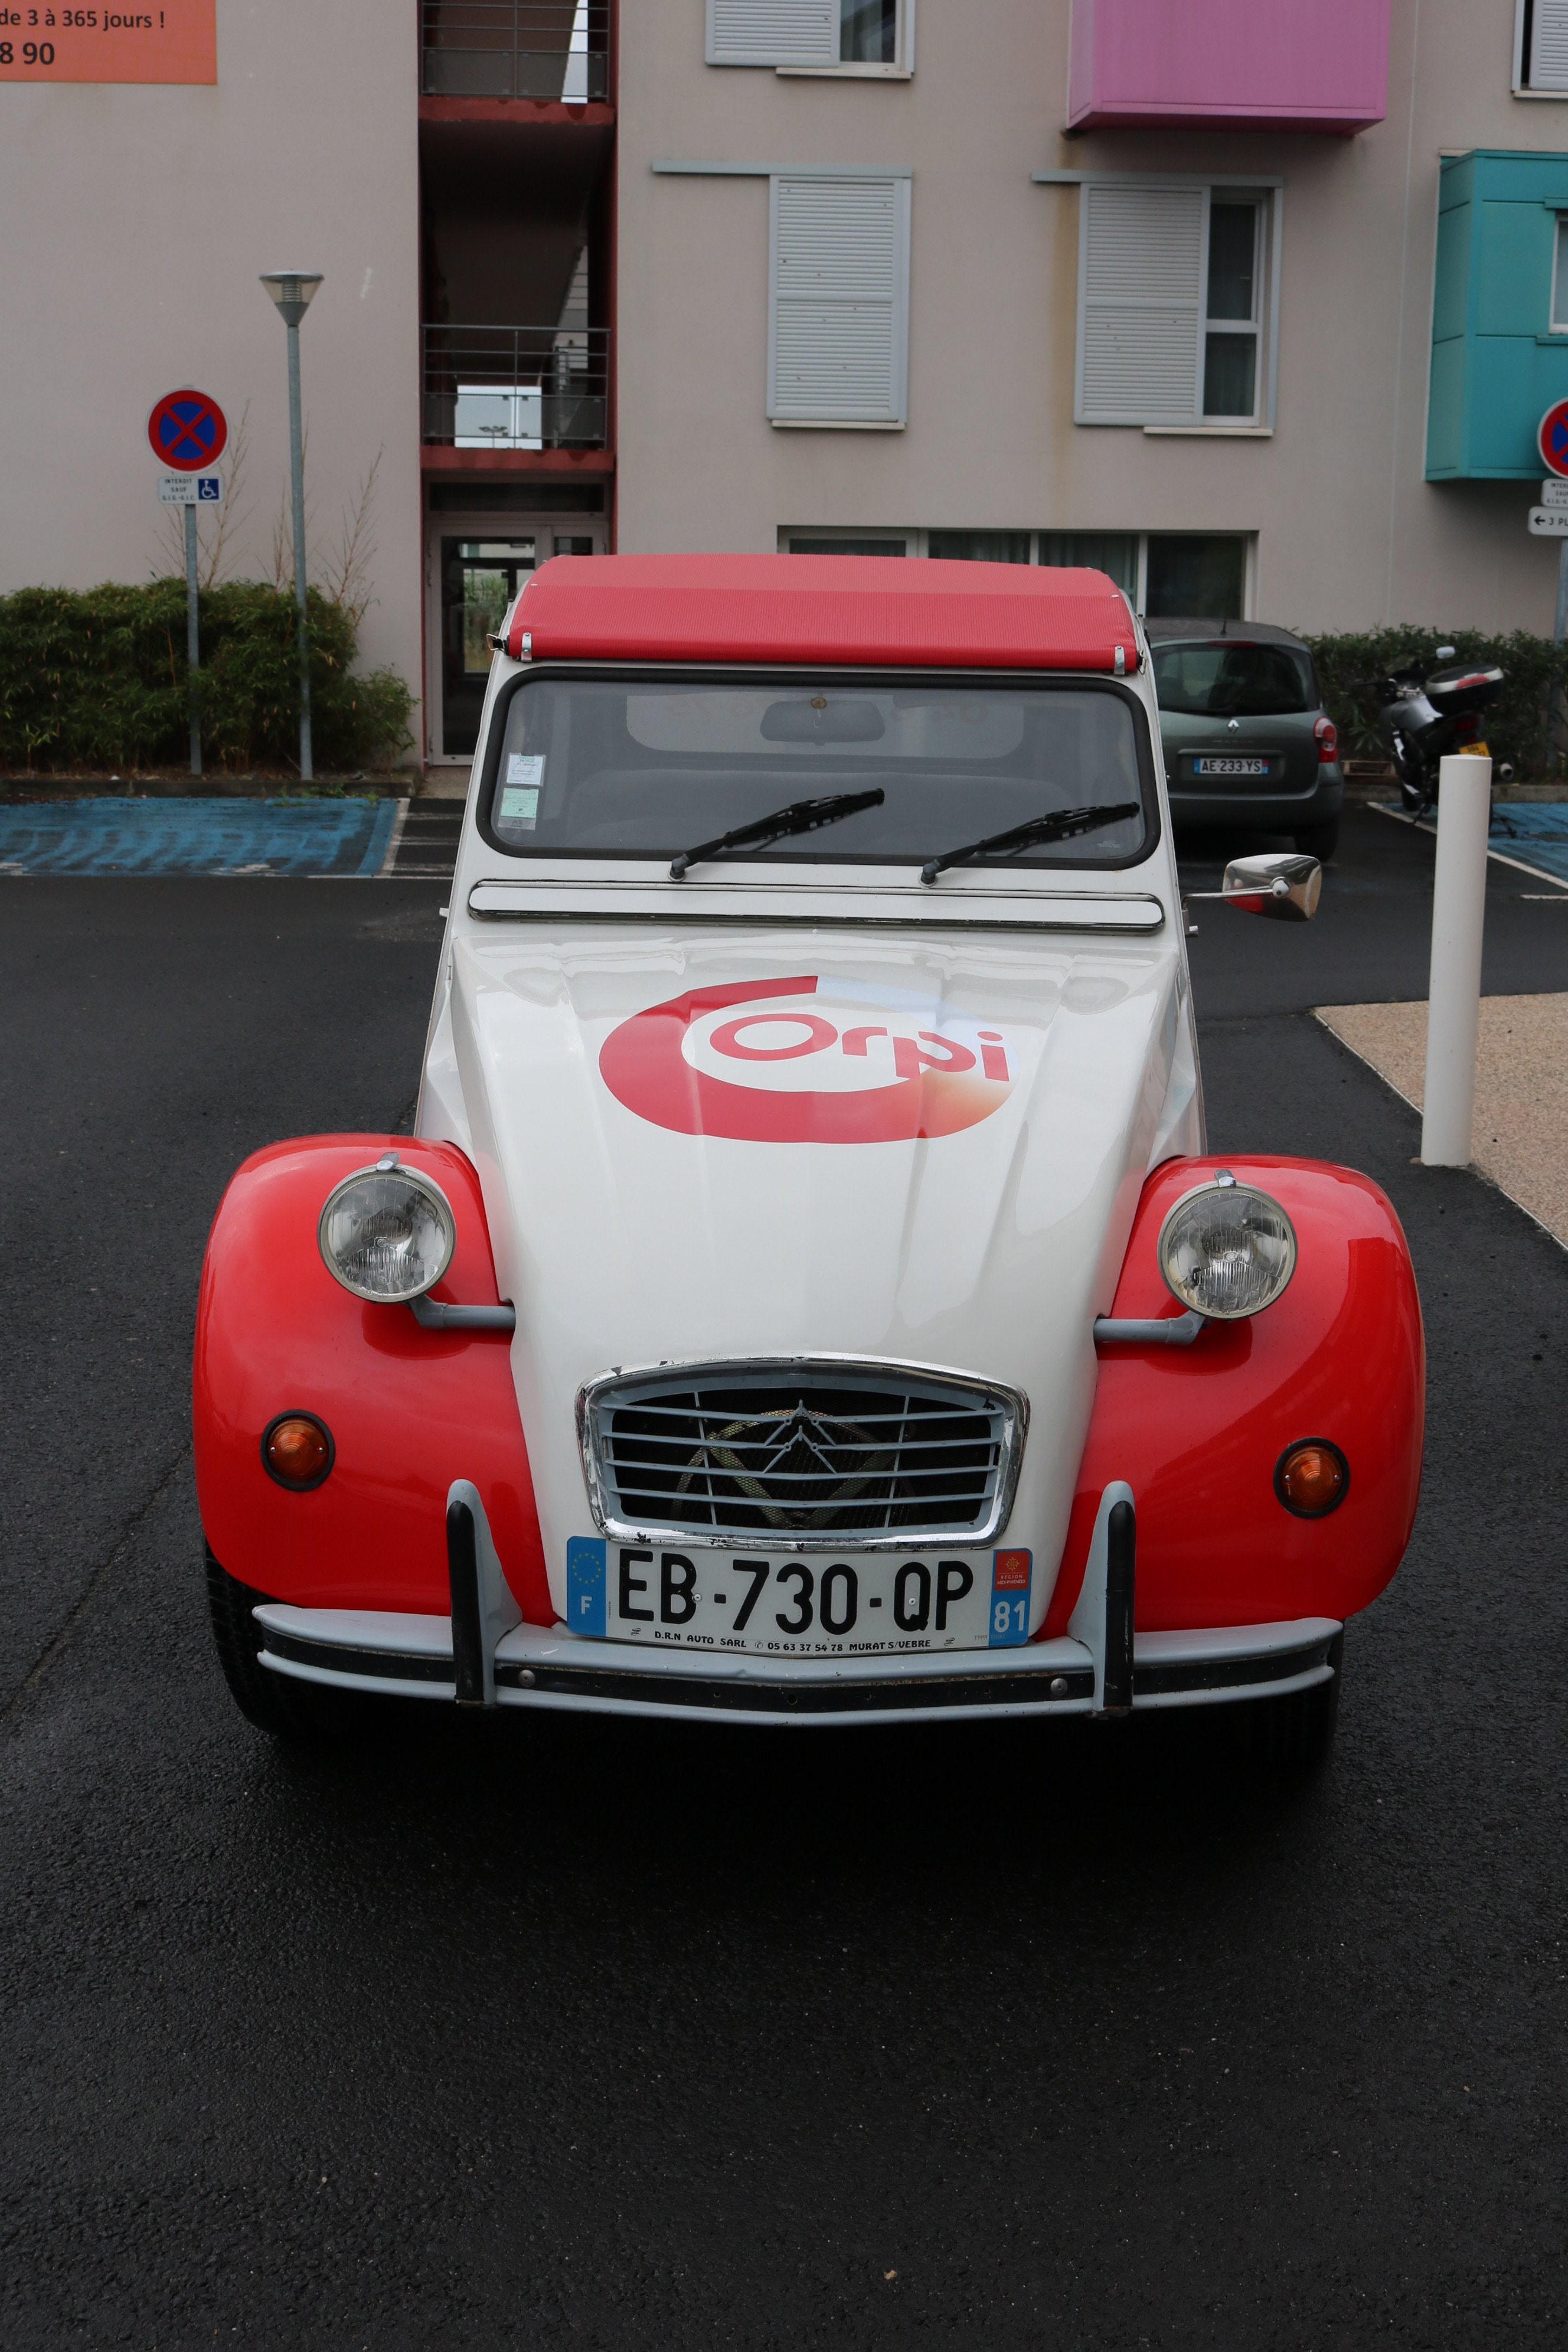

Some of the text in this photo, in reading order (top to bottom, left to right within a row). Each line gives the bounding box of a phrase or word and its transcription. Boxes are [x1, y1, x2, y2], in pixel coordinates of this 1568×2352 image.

[0, 9, 165, 31] de 3 à 365 jours !
[0, 42, 55, 65] 8 90
[1549, 517, 1554, 525] 3
[619, 1548, 974, 1635] EB-730-QP
[581, 1595, 592, 1615] F
[994, 1600, 1025, 1633] 81
[655, 1631, 681, 1641] D.R.N
[687, 1634, 714, 1644] AUTO
[720, 1638, 747, 1648] SARL
[767, 1642, 780, 1650] 05
[849, 1642, 886, 1651] MURAT
